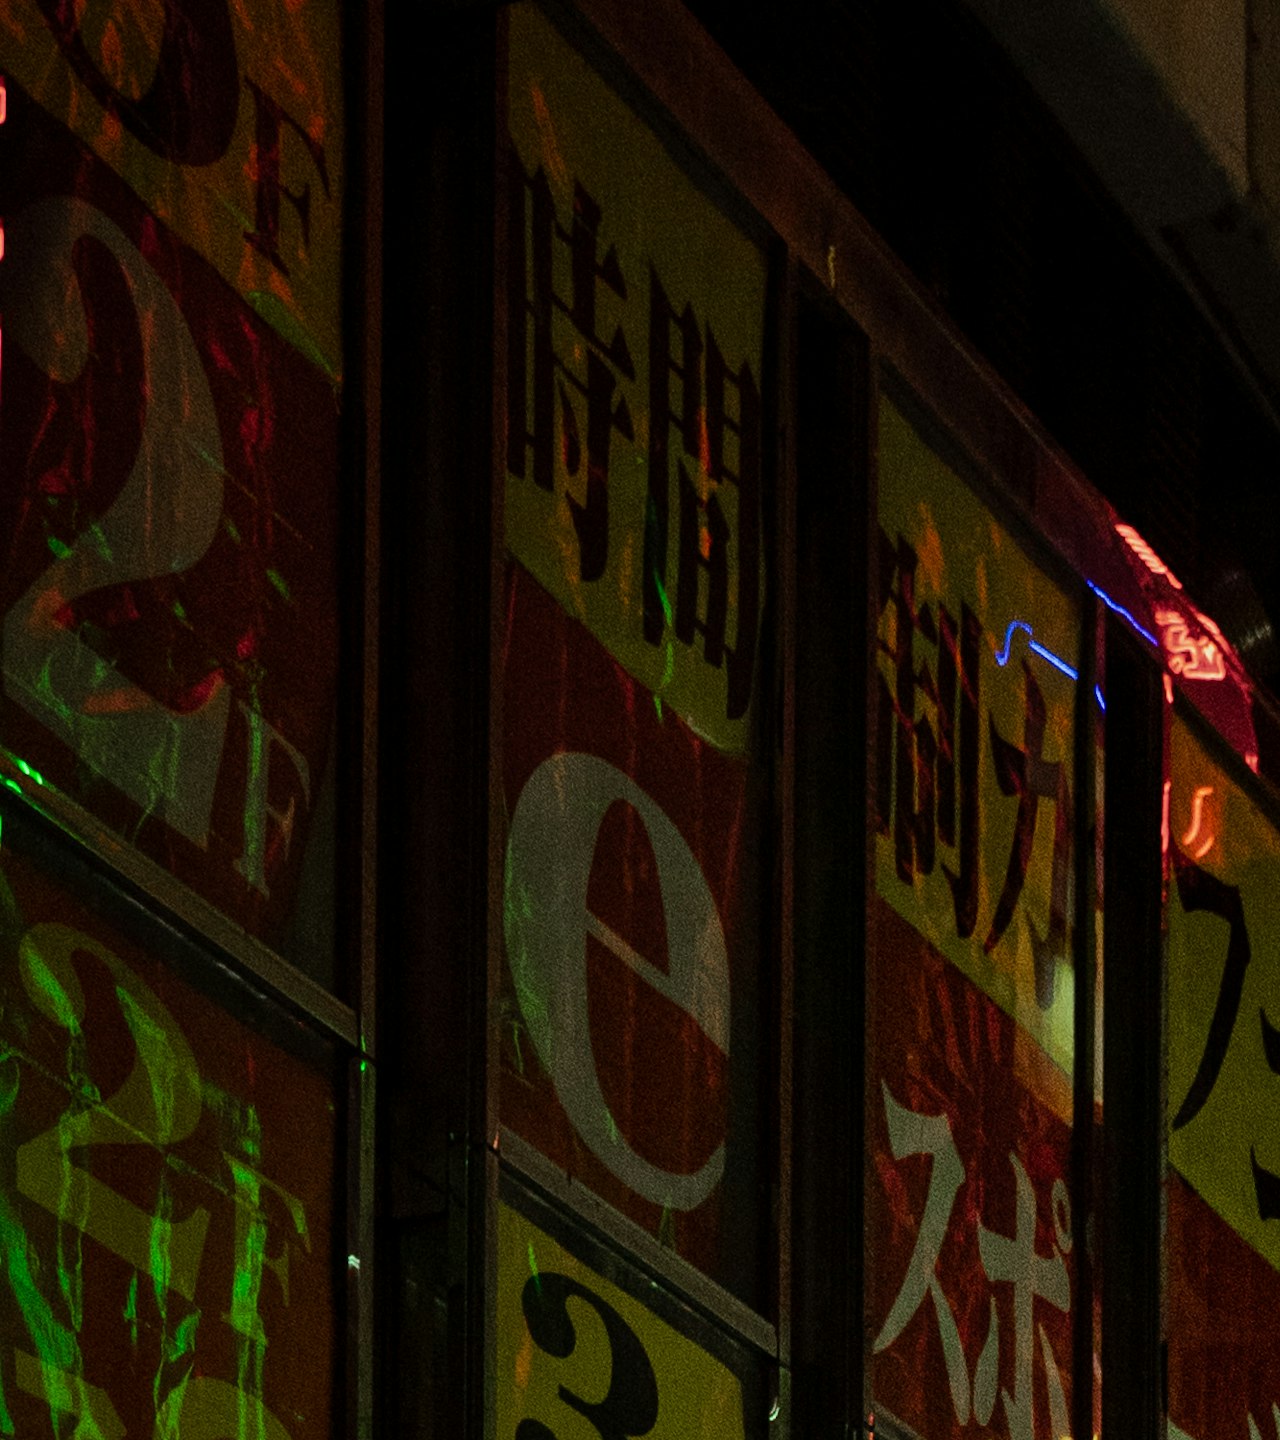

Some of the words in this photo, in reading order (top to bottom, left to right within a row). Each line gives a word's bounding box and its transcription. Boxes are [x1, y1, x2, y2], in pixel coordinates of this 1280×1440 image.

[0, 195, 312, 900] 2F
[505, 155, 760, 720] 時間
[15, 917, 312, 1357] 2F
[502, 750, 732, 1197] e
